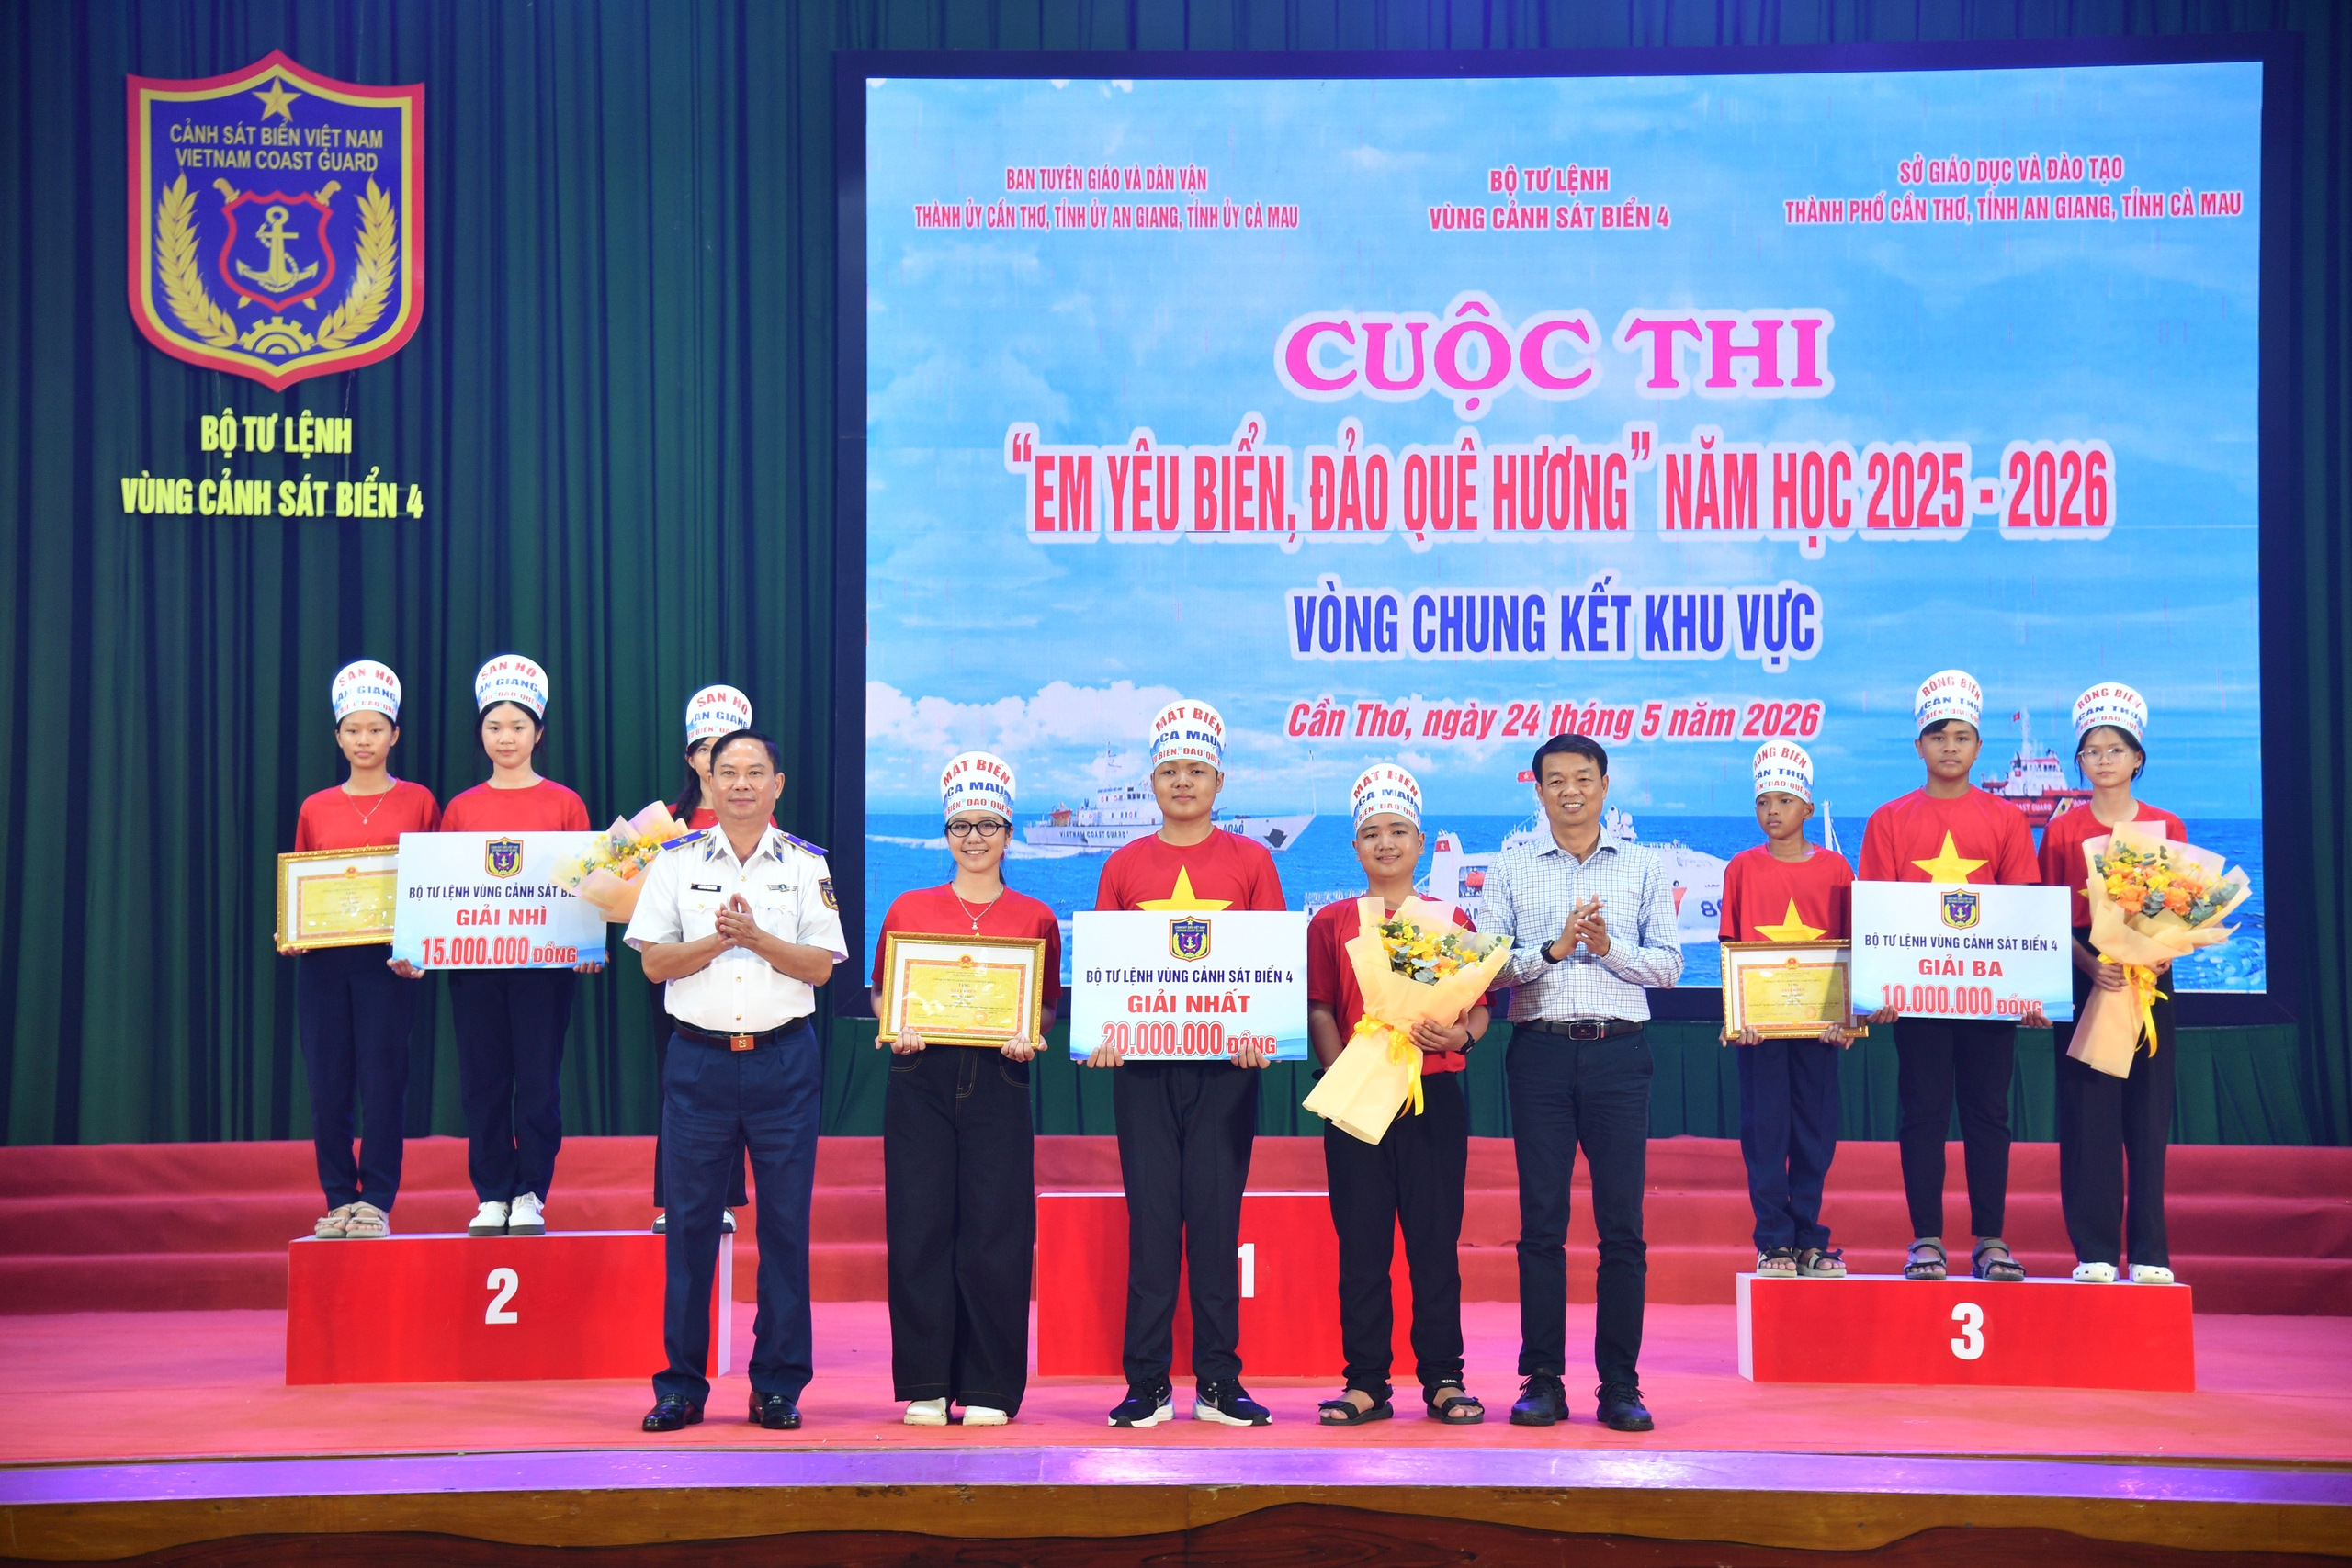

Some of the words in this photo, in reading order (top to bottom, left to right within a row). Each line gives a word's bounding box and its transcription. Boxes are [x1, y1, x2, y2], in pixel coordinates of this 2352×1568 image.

[169, 118, 219, 145] CẢNH
[222, 122, 257, 146] SÁT
[260, 118, 301, 148] BIỂN
[303, 122, 342, 152] VIỆT
[345, 129, 384, 149] NAM
[175, 147, 252, 169] VIETNAM
[255, 150, 313, 170] COAST
[317, 151, 379, 173] GUARD
[1899, 156, 1924, 184] SỞ
[1928, 156, 1971, 183] GIÁO
[1976, 159, 2013, 186] DỤC
[2018, 155, 2041, 181] VÀ
[2046, 154, 2084, 181] ĐÀO
[2089, 156, 2123, 184] TẠO
[1006, 168, 1035, 190] BAN
[1039, 164, 1083, 190] TUYÊN
[1087, 164, 1120, 190] GIÁO
[1124, 164, 1142, 190] VÀ
[1146, 164, 1175, 190] DÂN
[1179, 164, 1207, 195] VẬN
[1490, 164, 1518, 197] BỘ
[1524, 167, 1552, 192] TƯ
[1555, 164, 1609, 196] LỆNH
[915, 200, 961, 227] THÀNH
[965, 197, 982, 228] ỦY
[987, 198, 1016, 228] CẦN
[1020, 204, 1050, 231] THƠ,
[1054, 198, 1086, 227] TỈNH
[1090, 198, 1107, 228] ỦY
[1112, 206, 1132, 227] AN
[1136, 206, 1182, 231] GIANG,
[1186, 198, 1219, 228] TỈNH
[1223, 197, 1240, 228] ỦY
[1245, 200, 1263, 228] CÀ
[1267, 206, 1298, 228] MAU
[1430, 201, 1485, 230] VÙNG
[1492, 200, 1549, 230] CẢNH
[1555, 201, 1595, 229] SÁT
[1601, 198, 1651, 228] BIỂN
[1657, 206, 1670, 227] 4
[1785, 195, 1844, 223] THÀNH
[1849, 192, 1885, 222] PHỐ
[1890, 191, 1928, 222] CẦN
[1932, 197, 1972, 221] THƠ,
[1977, 191, 2018, 220] TỈNH
[2024, 197, 2050, 220] AN
[2054, 195, 2116, 220] GIANG,
[2122, 189, 2164, 217] TỈNH
[2170, 189, 2195, 217] CÀ
[2200, 192, 2242, 215] MAU
[1285, 300, 1592, 411] CUỘC
[1624, 318, 1823, 389] THI
[201, 407, 237, 459] BỘ
[242, 412, 278, 453] TƯ
[284, 409, 352, 459] LỆNH
[120, 469, 193, 515] VÙNG
[198, 467, 272, 516] CẢNH
[277, 473, 329, 517] SÁT
[335, 466, 398, 519] BIỂN
[406, 483, 424, 519] 4
[1107, 437, 1180, 532] YÊU
[1194, 422, 1296, 543] BIỂN,
[1309, 427, 1389, 531] ĐẢO
[1403, 436, 1478, 542] QUÊ
[1665, 436, 1758, 530] NĂM
[1772, 450, 1852, 548] HỌC
[1866, 451, 1965, 529] 2025
[1979, 488, 1994, 504] -
[2007, 449, 2108, 528] 2026
[1293, 581, 1398, 654] VÒNG
[1412, 594, 1546, 653] CHUNG
[1561, 575, 1632, 652] KẾT
[1645, 594, 1724, 652] KHU
[1736, 588, 1815, 665] VỰC
[338, 668, 367, 687] SAN
[481, 661, 507, 681] SAN
[495, 678, 538, 693] GIANG
[696, 692, 727, 707] SAN
[694, 711, 710, 722] AN
[1193, 706, 1223, 737] BIỂN
[1288, 698, 1346, 738] Cần
[1355, 703, 1412, 740] Thơ,
[1422, 702, 1498, 741] ngày
[1501, 703, 1540, 737] 24
[1548, 702, 1634, 741] tháng
[1640, 703, 1663, 737] 5
[1668, 702, 1736, 737] năm
[1742, 703, 1821, 737] 2026
[1186, 729, 1218, 746] MAU
[976, 759, 1011, 785] BIỂN
[969, 782, 1004, 795] MAU
[1381, 788, 1415, 805] MAU
[409, 885, 424, 900] BỘ
[426, 885, 441, 899] TƯ
[443, 884, 469, 901] LỆNH
[474, 883, 502, 898] VÙNG
[504, 882, 535, 898] CẢNH
[537, 883, 559, 898] SÁT
[456, 904, 501, 927] GIẢI
[508, 905, 548, 926] NHÌ
[422, 935, 531, 966] 15.000.000
[532, 941, 578, 964] ĐỒNG
[1865, 932, 1879, 950] BỘ
[1883, 933, 1897, 948] TƯ
[1899, 933, 1927, 952] LỆNH
[1930, 934, 1960, 949] VÙNG
[1963, 934, 1994, 950] CẢNH
[1997, 935, 2018, 951] SÁT
[2021, 935, 2048, 953] BIỂN
[2051, 941, 2059, 953] 4
[1086, 967, 1102, 987] BỘ
[1105, 968, 1121, 984] TƯ
[1123, 967, 1153, 987] LỆNH
[1157, 966, 1189, 984] VÙNG
[1193, 965, 1225, 984] CẢNH
[1228, 966, 1251, 984] SÁT
[1254, 964, 1283, 984] BIỂN
[1286, 970, 1294, 984] 4
[1918, 954, 1964, 977] GIẢI
[1973, 960, 2004, 977] BA
[1127, 988, 1177, 1014] GIẢI
[1185, 987, 1251, 1014] NHẤT
[1882, 984, 1993, 1016] 10.000.000
[1102, 1022, 1224, 1056] 20.000.000
[1238, 1243, 1255, 1298] 1
[485, 1267, 519, 1325] 2
[1951, 1302, 1984, 1360] 3
